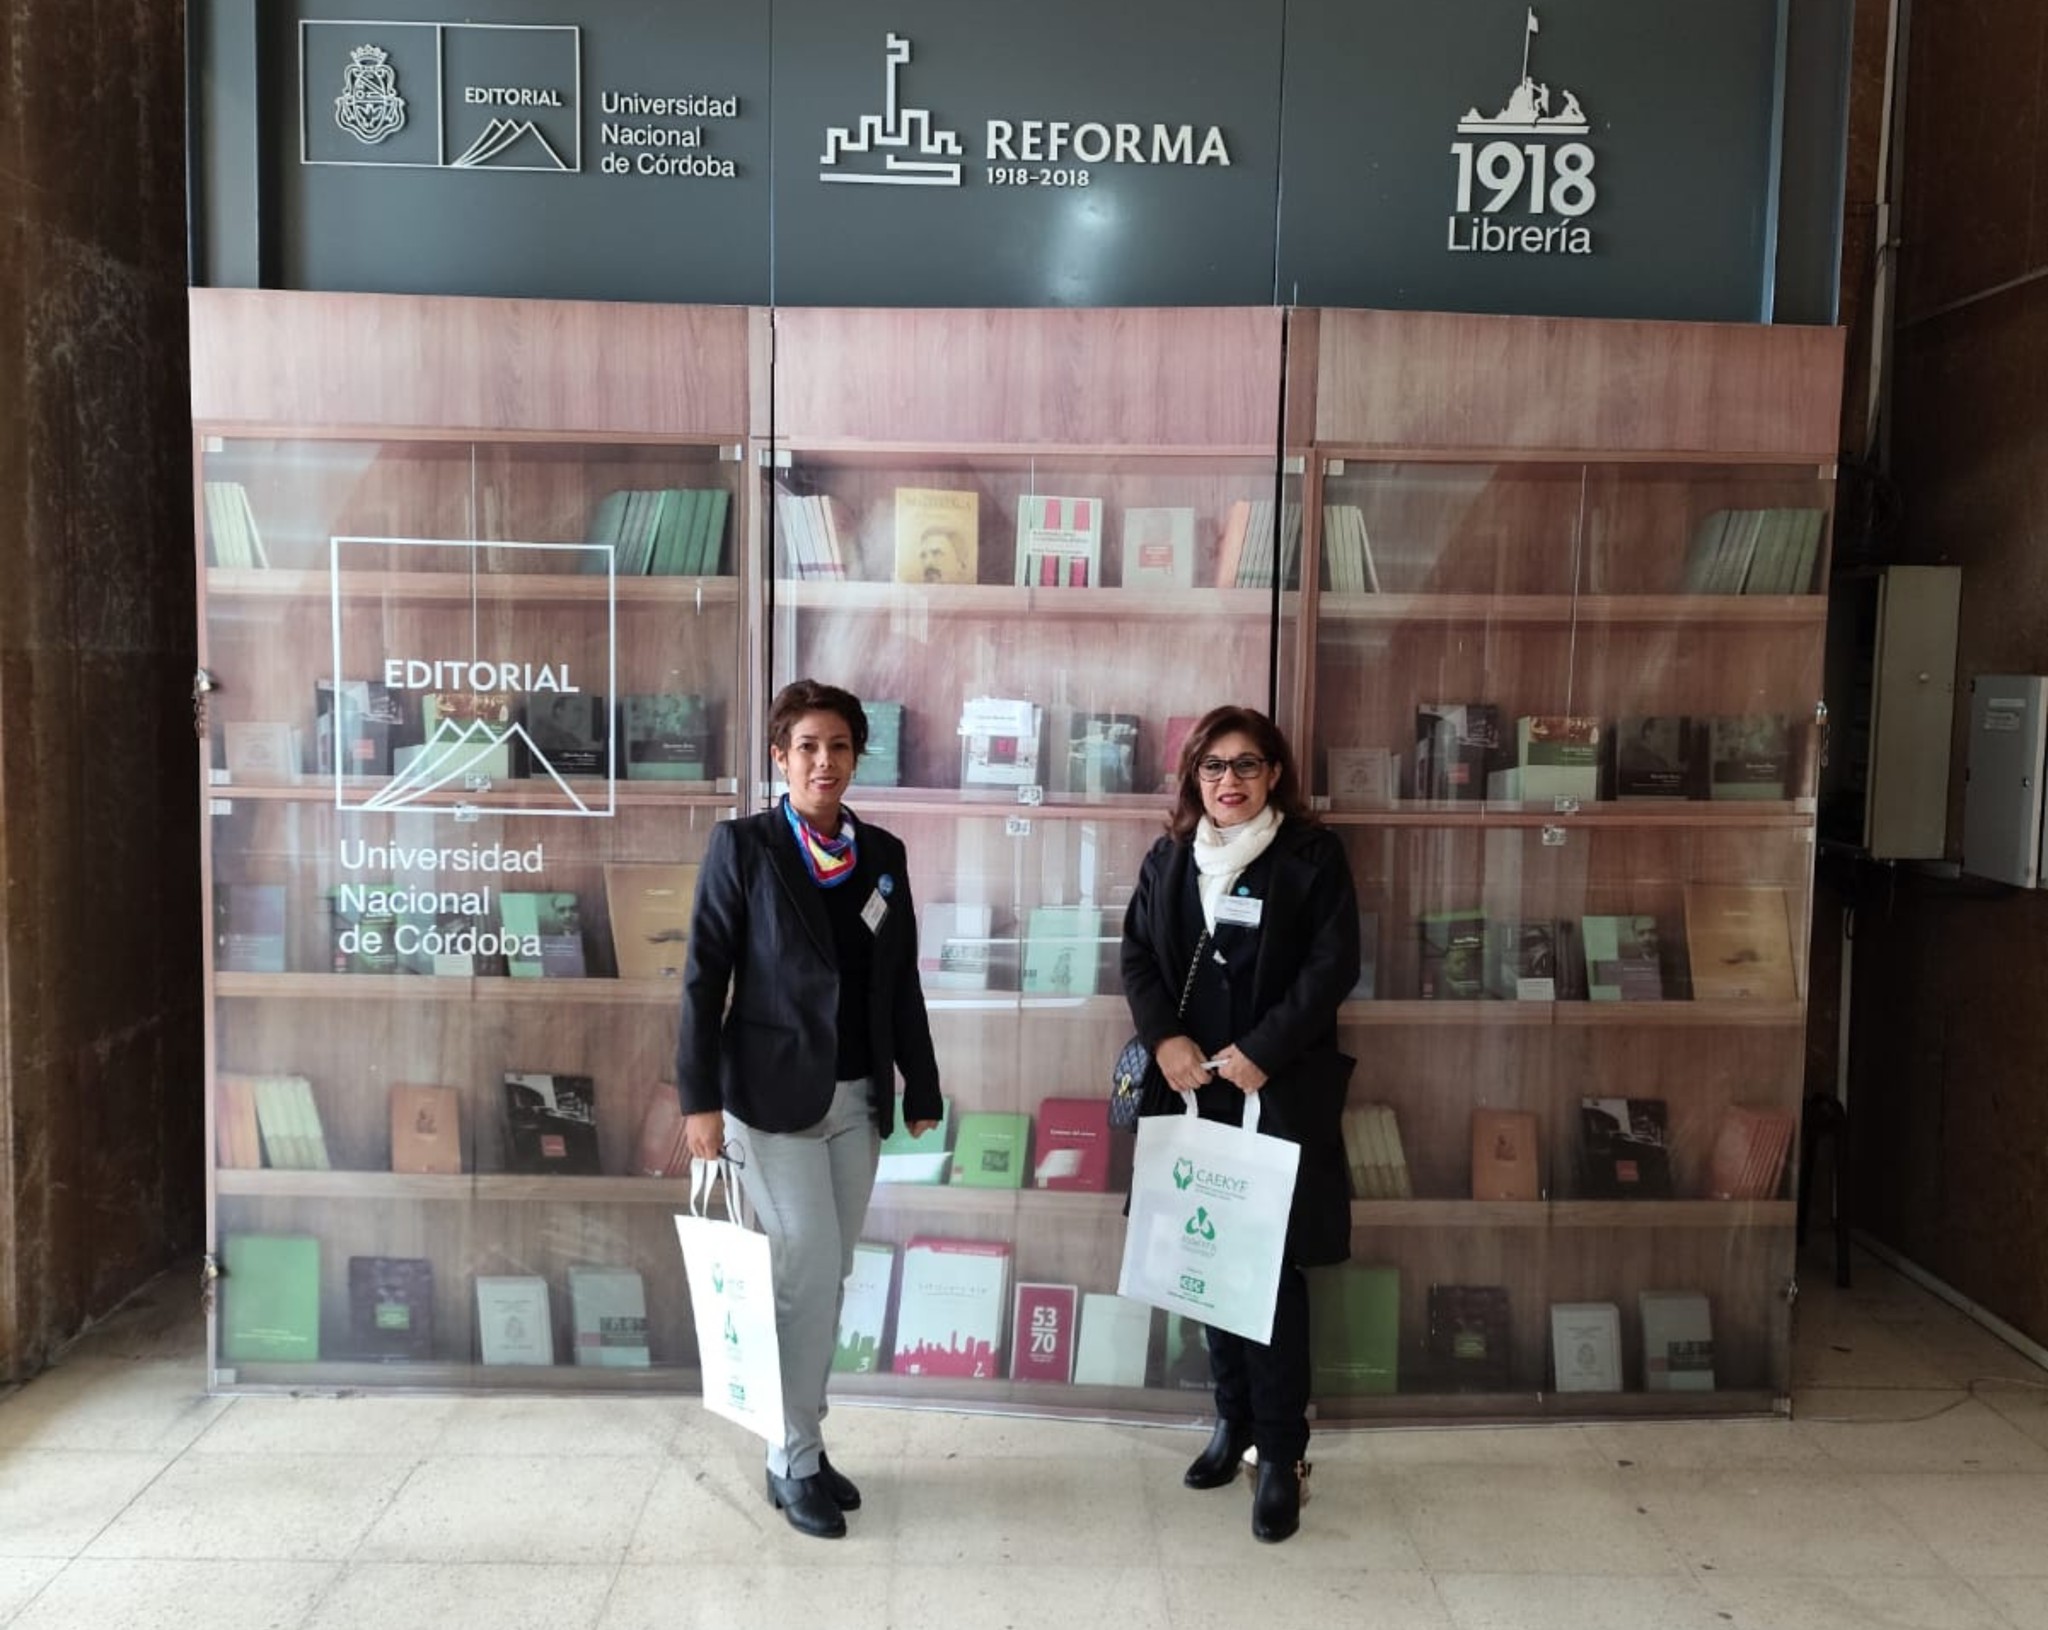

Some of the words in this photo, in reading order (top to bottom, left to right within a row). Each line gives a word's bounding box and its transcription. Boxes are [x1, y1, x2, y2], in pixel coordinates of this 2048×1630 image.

[465, 87, 562, 107] EDITORIAL
[601, 92, 737, 119] Universidad
[601, 123, 702, 149] Nacional
[985, 120, 1230, 166] REFORMA
[601, 151, 631, 176] de
[636, 151, 736, 178] Córdoba
[986, 167, 1090, 188] 1918-2018
[1450, 141, 1597, 217] 1918
[1447, 217, 1592, 254] Librería
[384, 659, 580, 693] EDITORIAL
[340, 840, 544, 874] Universidad
[340, 882, 490, 916] Nacional
[338, 925, 383, 955] de
[394, 924, 543, 957] Córdoba
[1032, 1305, 1057, 1328] 53
[1030, 1332, 1057, 1354] 70
